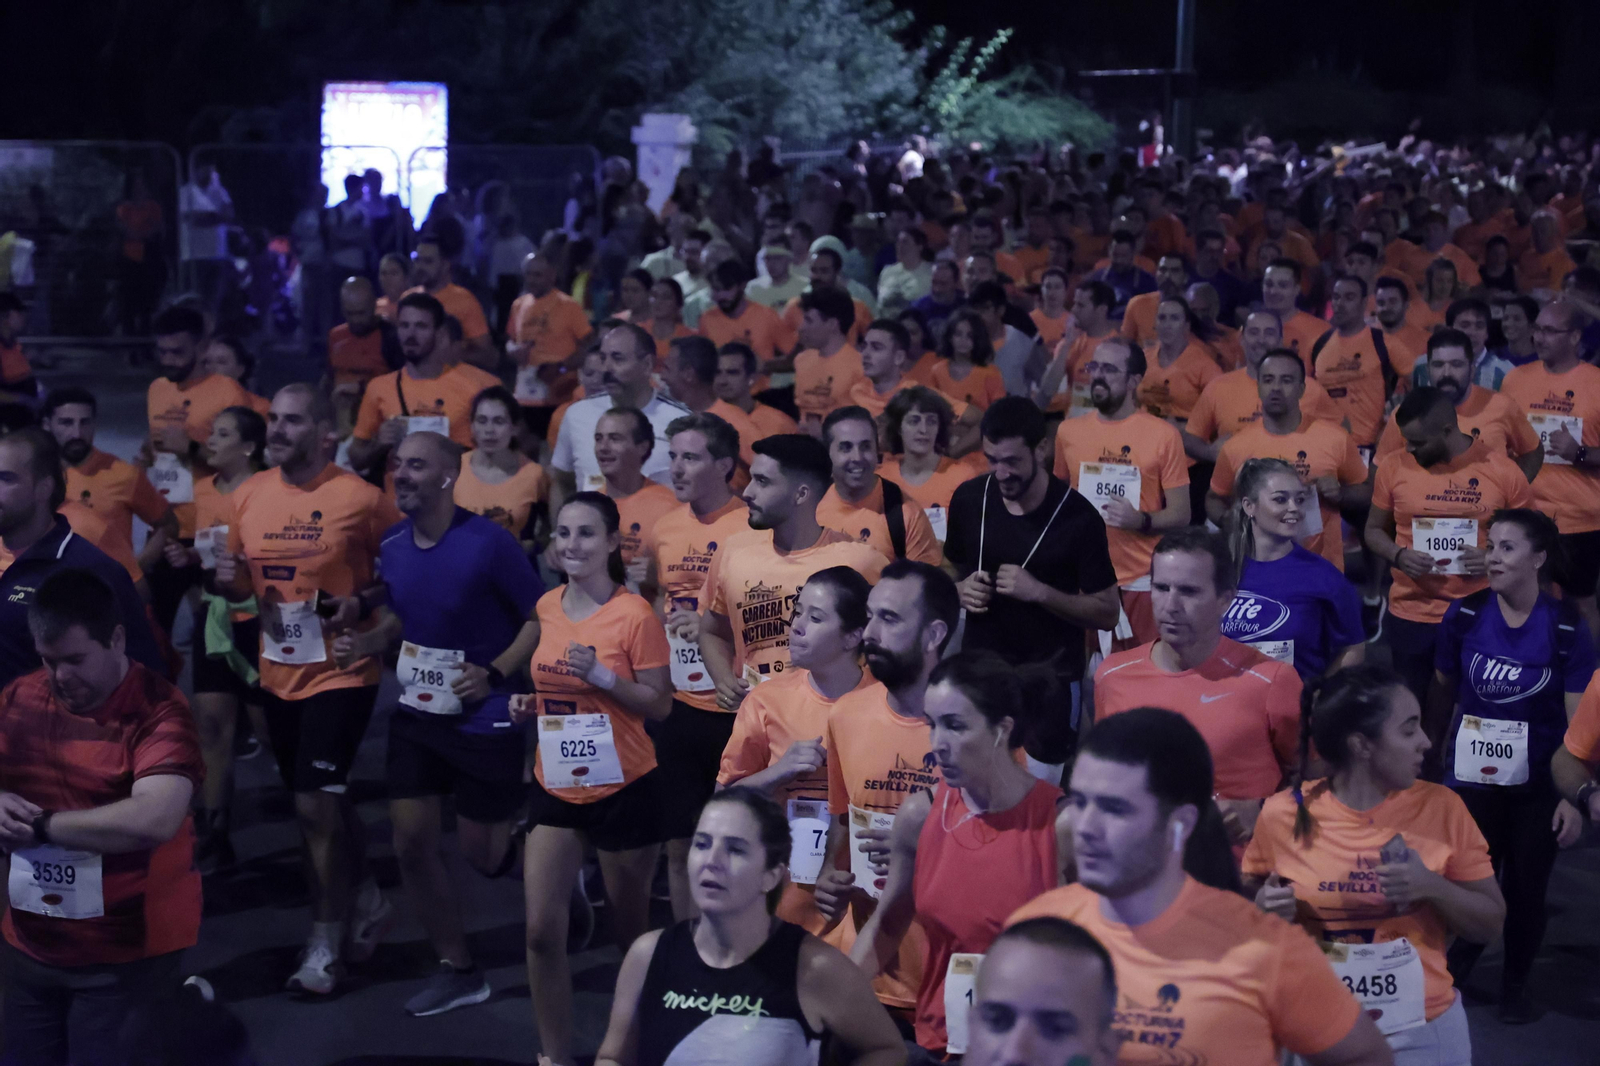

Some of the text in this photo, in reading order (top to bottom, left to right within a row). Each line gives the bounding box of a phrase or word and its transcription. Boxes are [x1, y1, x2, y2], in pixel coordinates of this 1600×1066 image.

[1096, 482, 1125, 497] 8546
[1443, 489, 1482, 497] NOCTURNA
[1424, 494, 1460, 502] SEVILLA
[667, 564, 697, 572] SEVILLA
[742, 600, 782, 624] CARRERA
[411, 667, 444, 686] 7188
[537, 663, 571, 676] SEVILLA
[560, 739, 597, 758] 6225
[1470, 739, 1513, 759] 17800
[863, 779, 908, 792] SEVILLA
[32, 860, 76, 885] 3539
[1317, 881, 1377, 893] SEVILLA
[662, 988, 770, 1030] mickey
